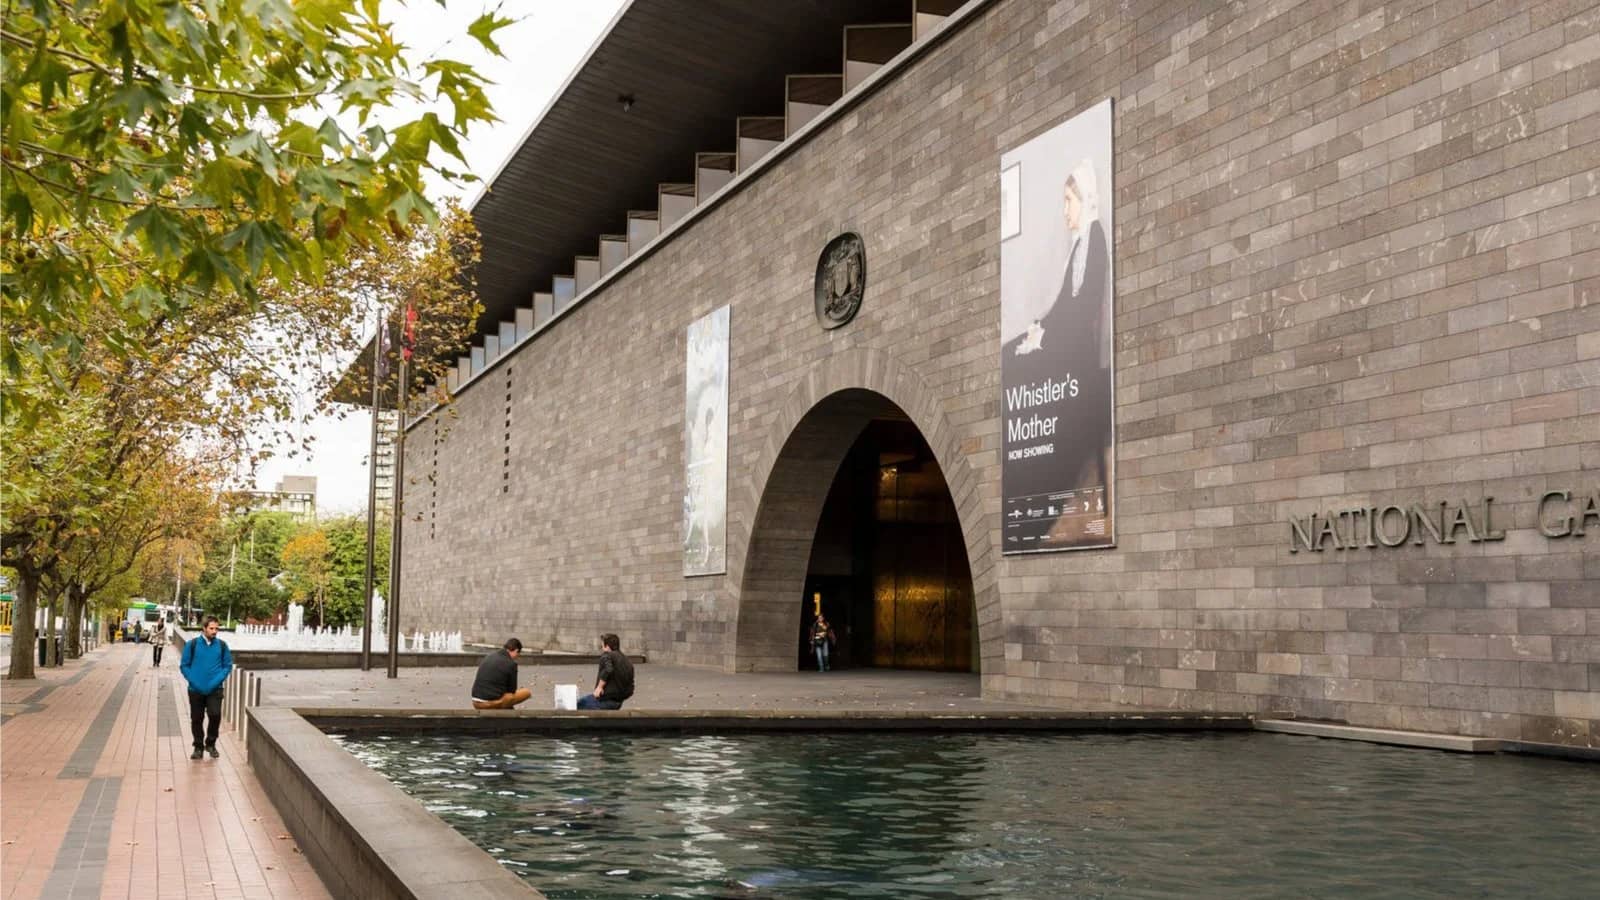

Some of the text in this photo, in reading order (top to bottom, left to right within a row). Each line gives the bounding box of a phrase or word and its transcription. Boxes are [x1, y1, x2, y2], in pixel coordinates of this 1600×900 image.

[1006, 373, 1079, 412] Whistler's
[1008, 413, 1058, 443] Mother
[1008, 443, 1054, 460] NOW SHOWING
[1288, 496, 1506, 553] NATIONAL
